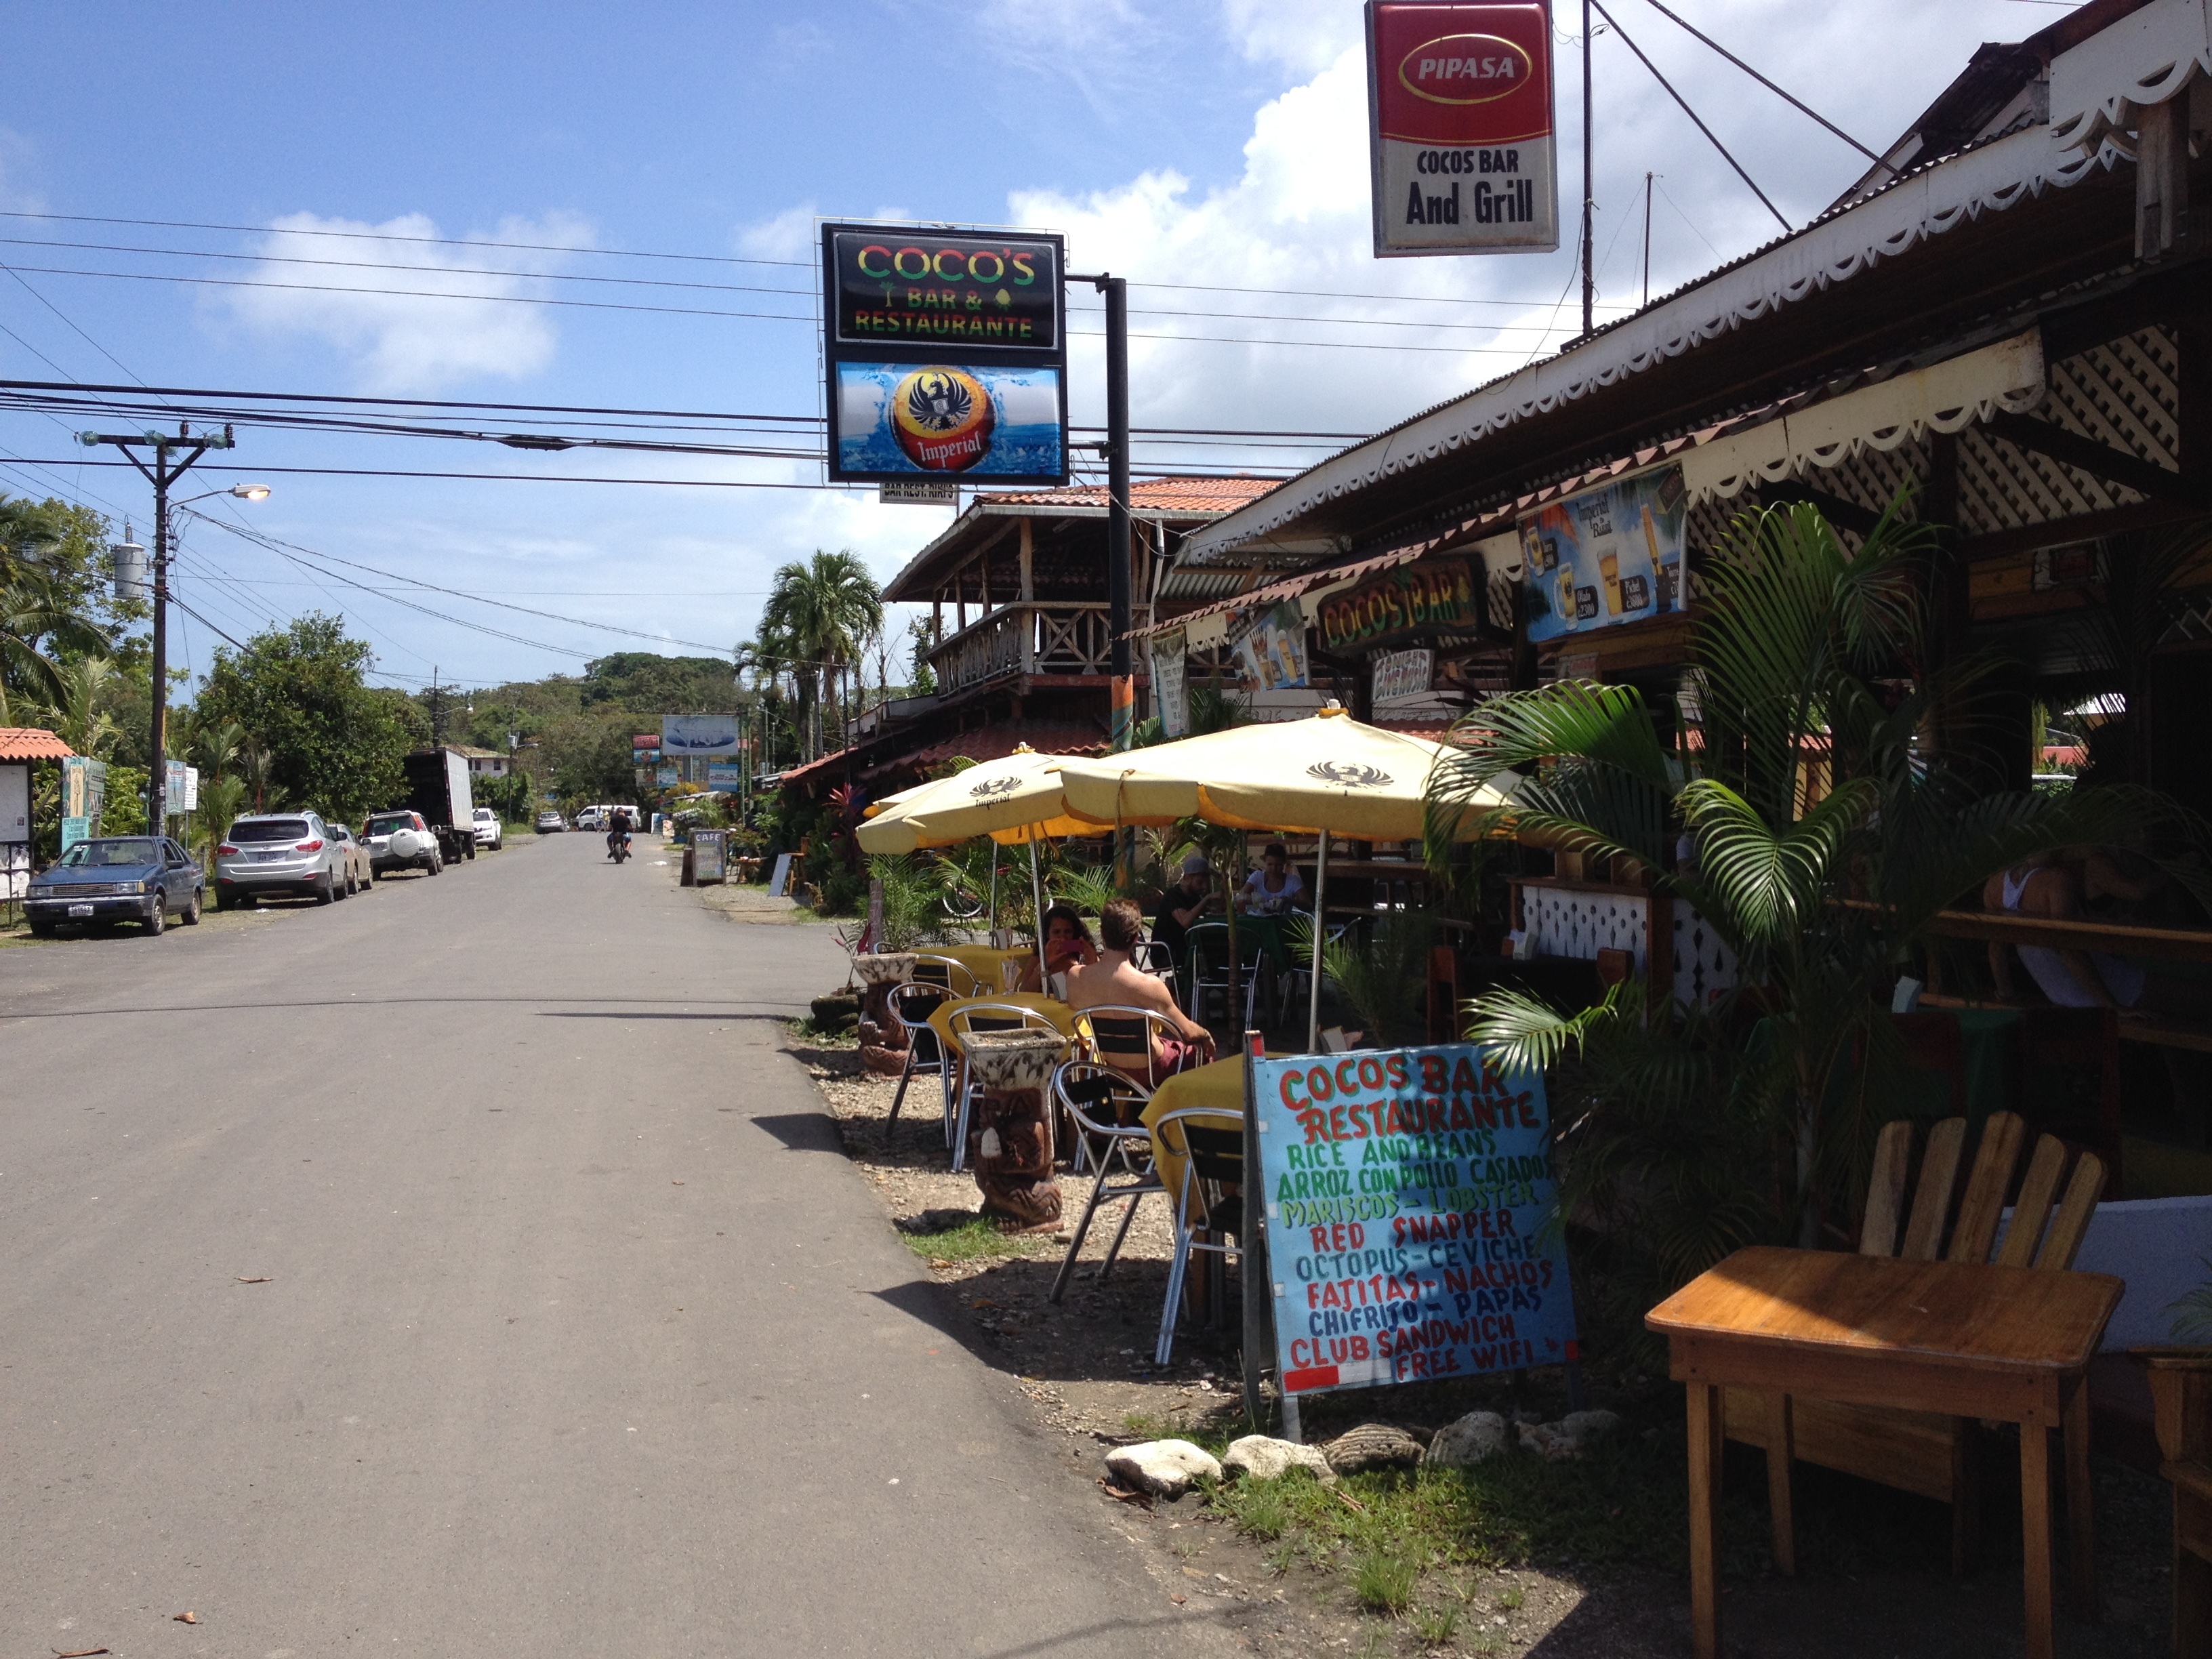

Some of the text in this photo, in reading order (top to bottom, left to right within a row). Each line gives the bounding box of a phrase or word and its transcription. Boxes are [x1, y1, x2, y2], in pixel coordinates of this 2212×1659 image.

[1418, 57, 1515, 80] PIPASA
[1417, 149, 1519, 174] COCOS BAR
[1406, 179, 1533, 224] And Grill
[857, 245, 1036, 285] COCO'S
[907, 287, 983, 311] BAR &
[855, 310, 1032, 338] RESTAURANTE
[917, 431, 983, 469] Imperial
[884, 483, 901, 497] BAR
[1576, 492, 1610, 529] Imperial
[1324, 574, 1458, 646] COCOS BAR
[976, 793, 1011, 811] Imperial
[696, 833, 720, 842] CAFE
[1279, 1054, 1509, 1111] COCOS BAR
[1296, 1091, 1540, 1145] RESTAURANTE
[1287, 1128, 1496, 1170] RICE AND BEANS
[1277, 1169, 1354, 1202] ARROZ
[1358, 1168, 1398, 1194] CON
[1282, 1193, 1399, 1229] MARISCOS
[1429, 1184, 1539, 1214] LOBSTER
[1310, 1208, 1517, 1253] RED SNAPPER
[1443, 1259, 1553, 1294] NACHOS
[1454, 1285, 1542, 1319] PAPAS
[1290, 1313, 1516, 1368] CLUB SANDWICH
[1396, 1339, 1533, 1381] FREE WIFI
